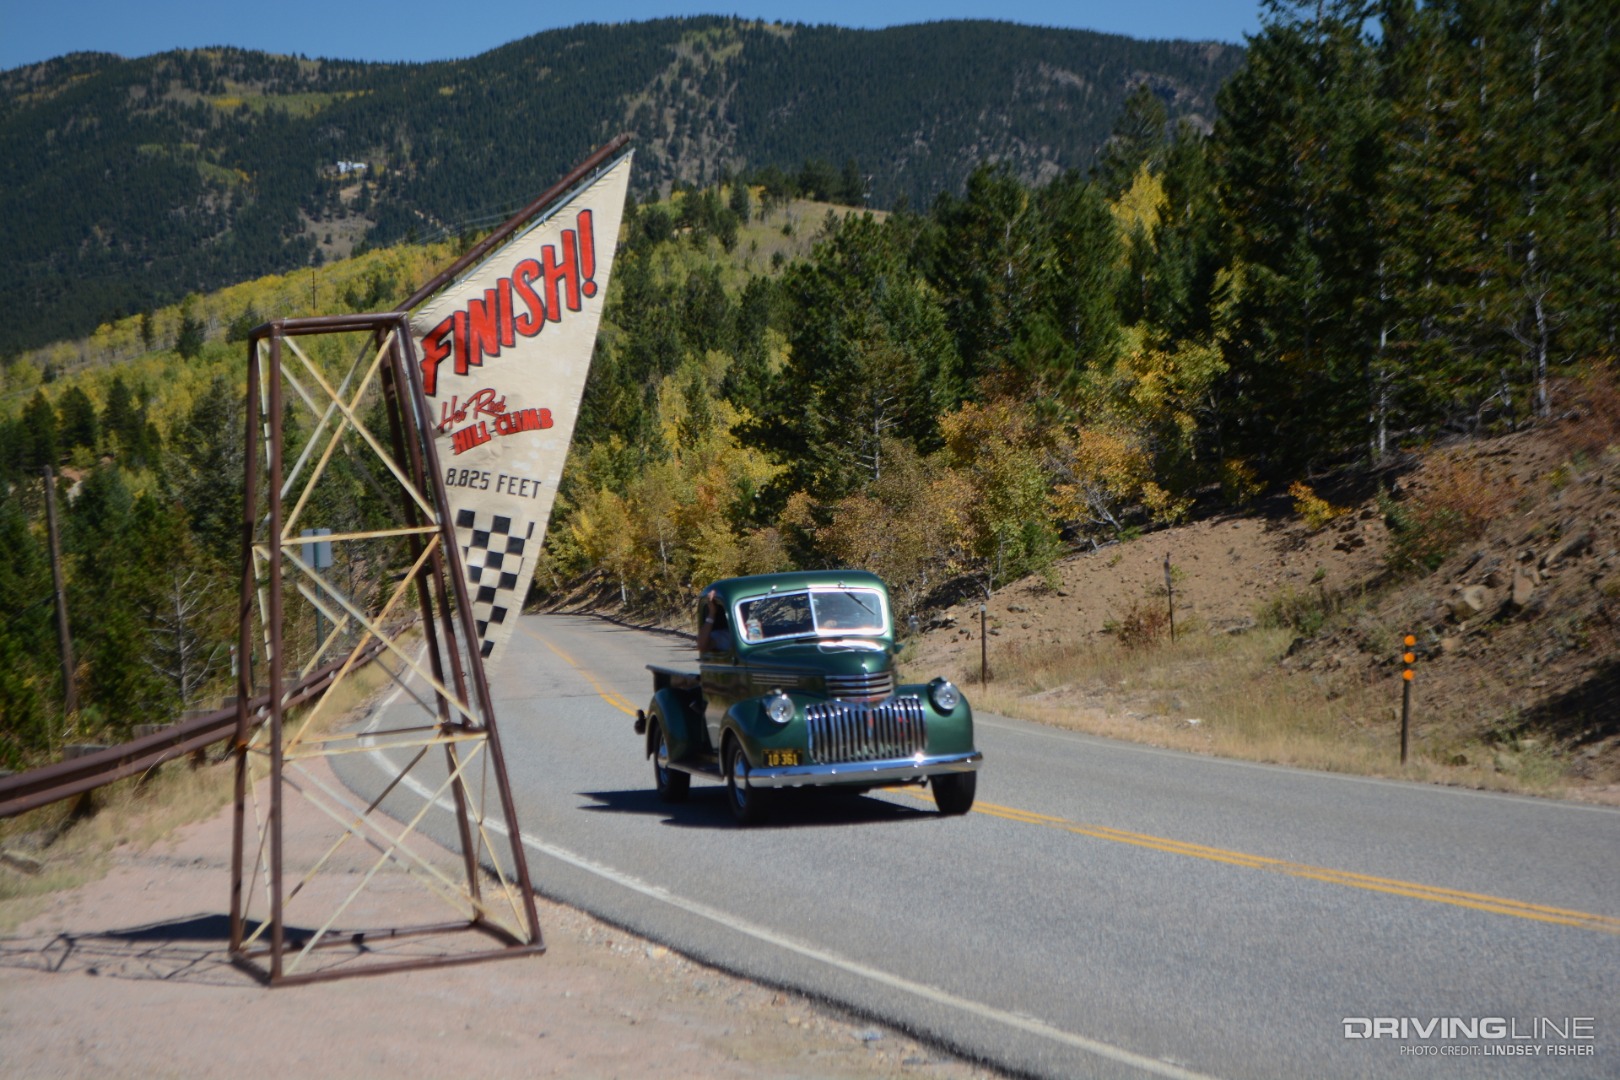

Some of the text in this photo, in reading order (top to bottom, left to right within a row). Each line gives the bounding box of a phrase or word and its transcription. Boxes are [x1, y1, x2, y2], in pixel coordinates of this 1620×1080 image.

[420, 209, 597, 397] FINISH!
[450, 408, 553, 455] HILL CLIMB
[445, 468, 541, 499] 8,825 FEET
